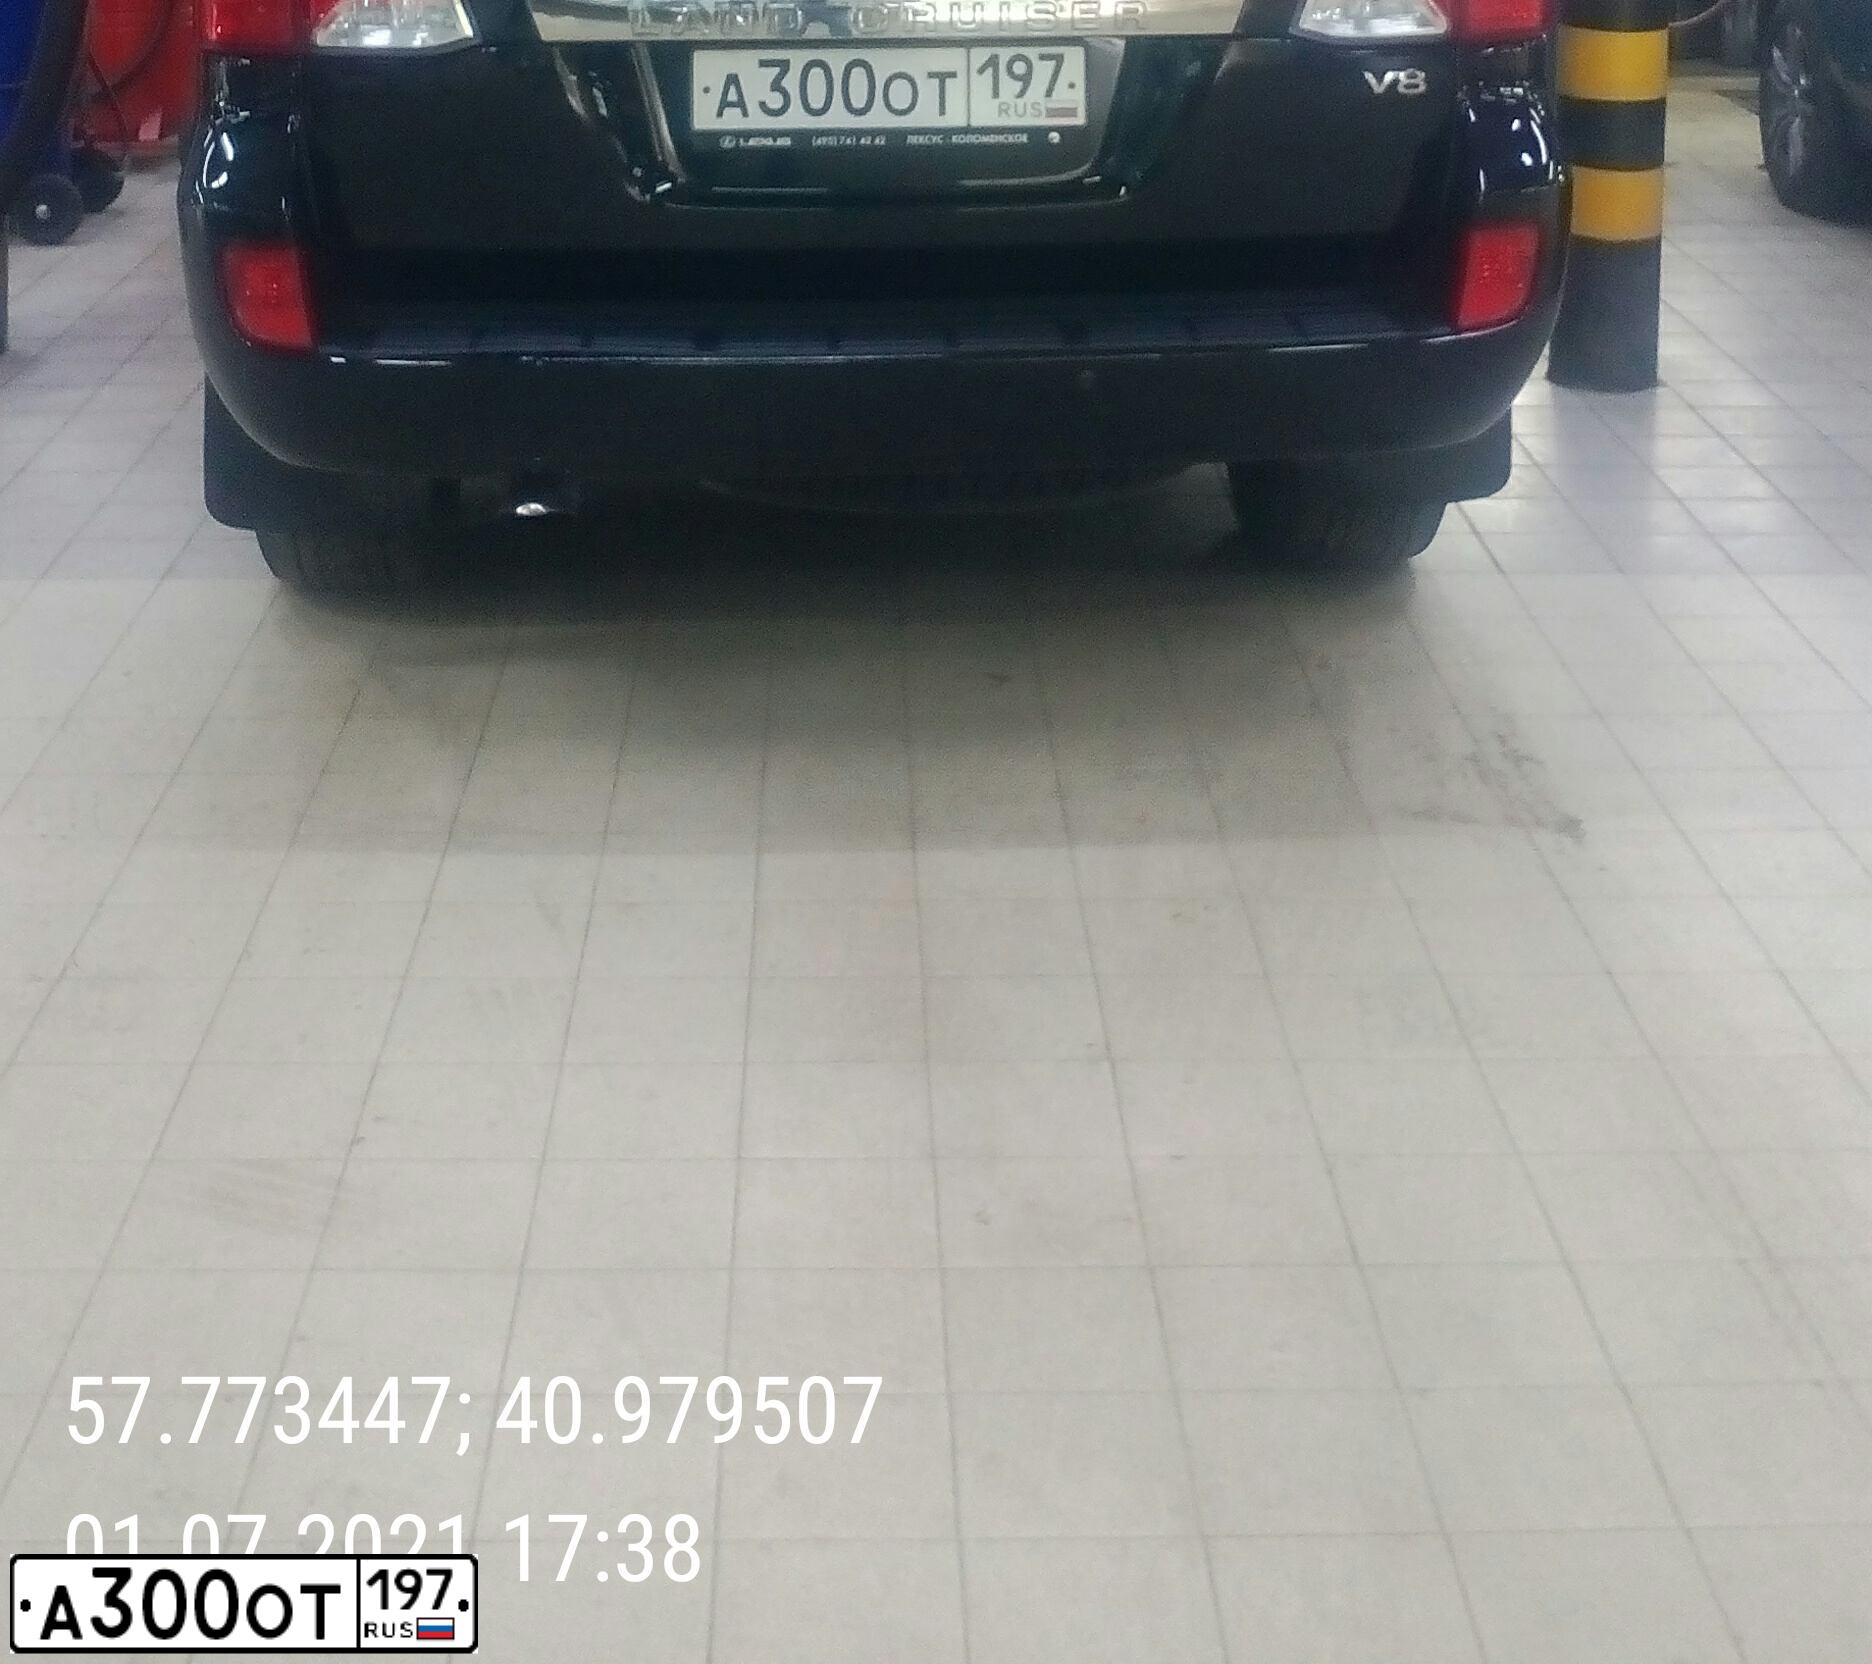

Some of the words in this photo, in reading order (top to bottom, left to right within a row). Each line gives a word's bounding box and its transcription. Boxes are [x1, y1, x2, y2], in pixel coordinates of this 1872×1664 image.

[628, 0, 803, 37] LAND
[850, 0, 1149, 34] CRUISER
[716, 58, 957, 118] А300ОТ
[976, 52, 1065, 99] 197
[1362, 68, 1427, 95] V8
[999, 101, 1043, 119] RUS
